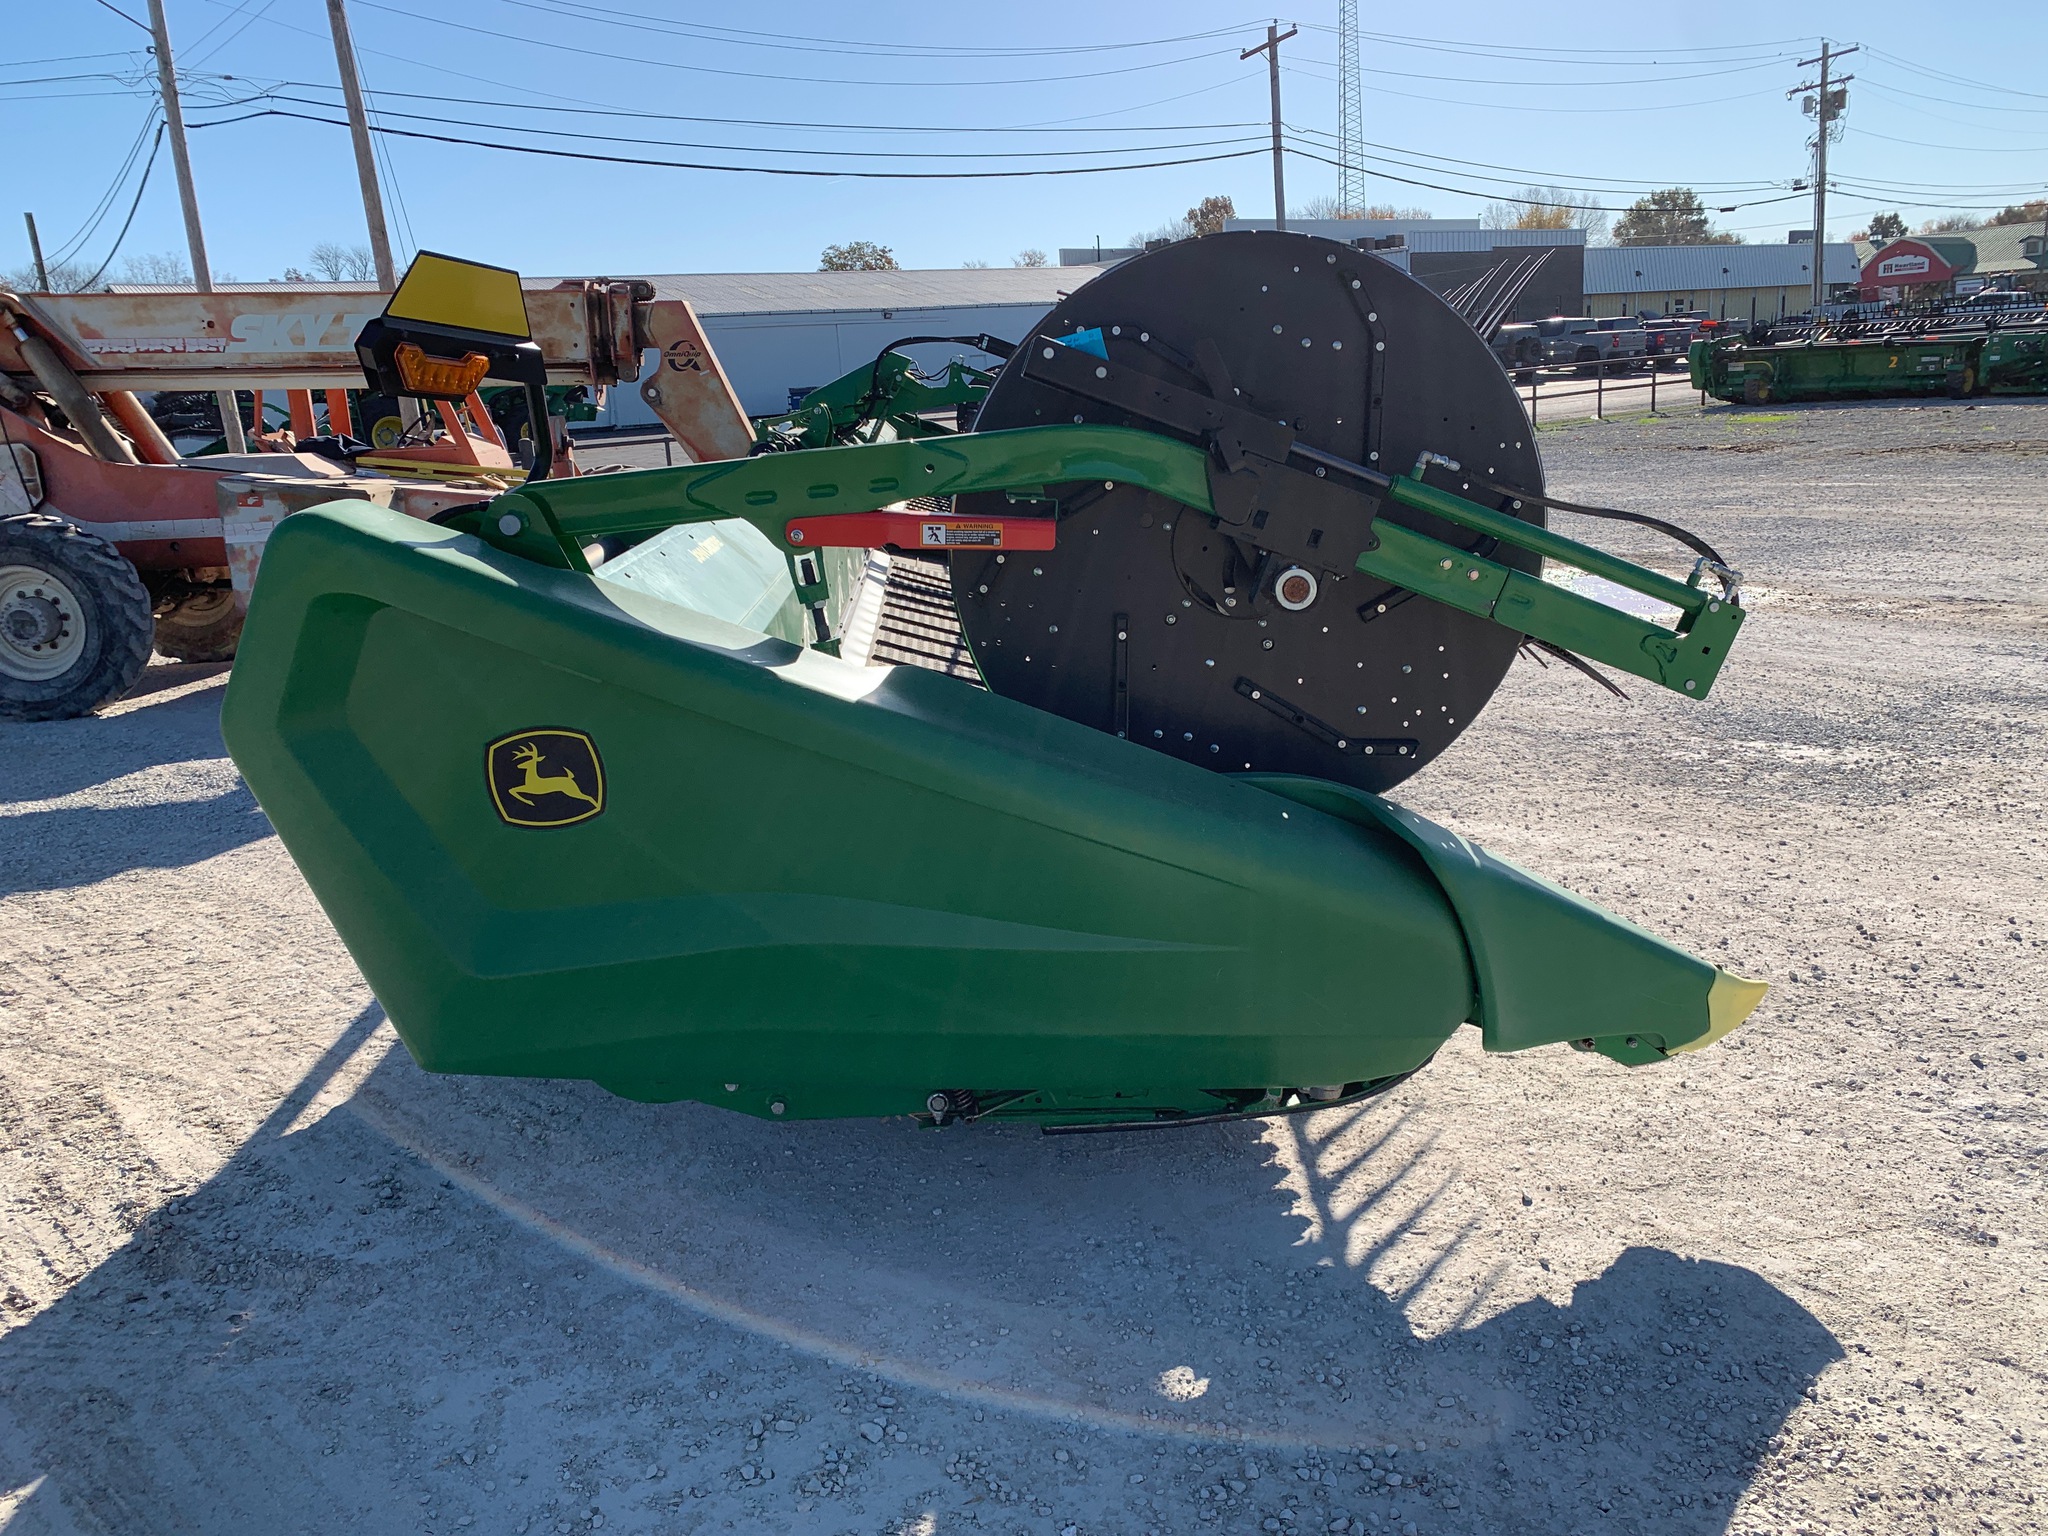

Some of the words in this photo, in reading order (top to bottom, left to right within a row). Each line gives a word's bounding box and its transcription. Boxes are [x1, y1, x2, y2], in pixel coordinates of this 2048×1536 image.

[227, 313, 377, 353] SKYT
[663, 350, 701, 358] OmniQuip
[1888, 355, 1899, 368] 2
